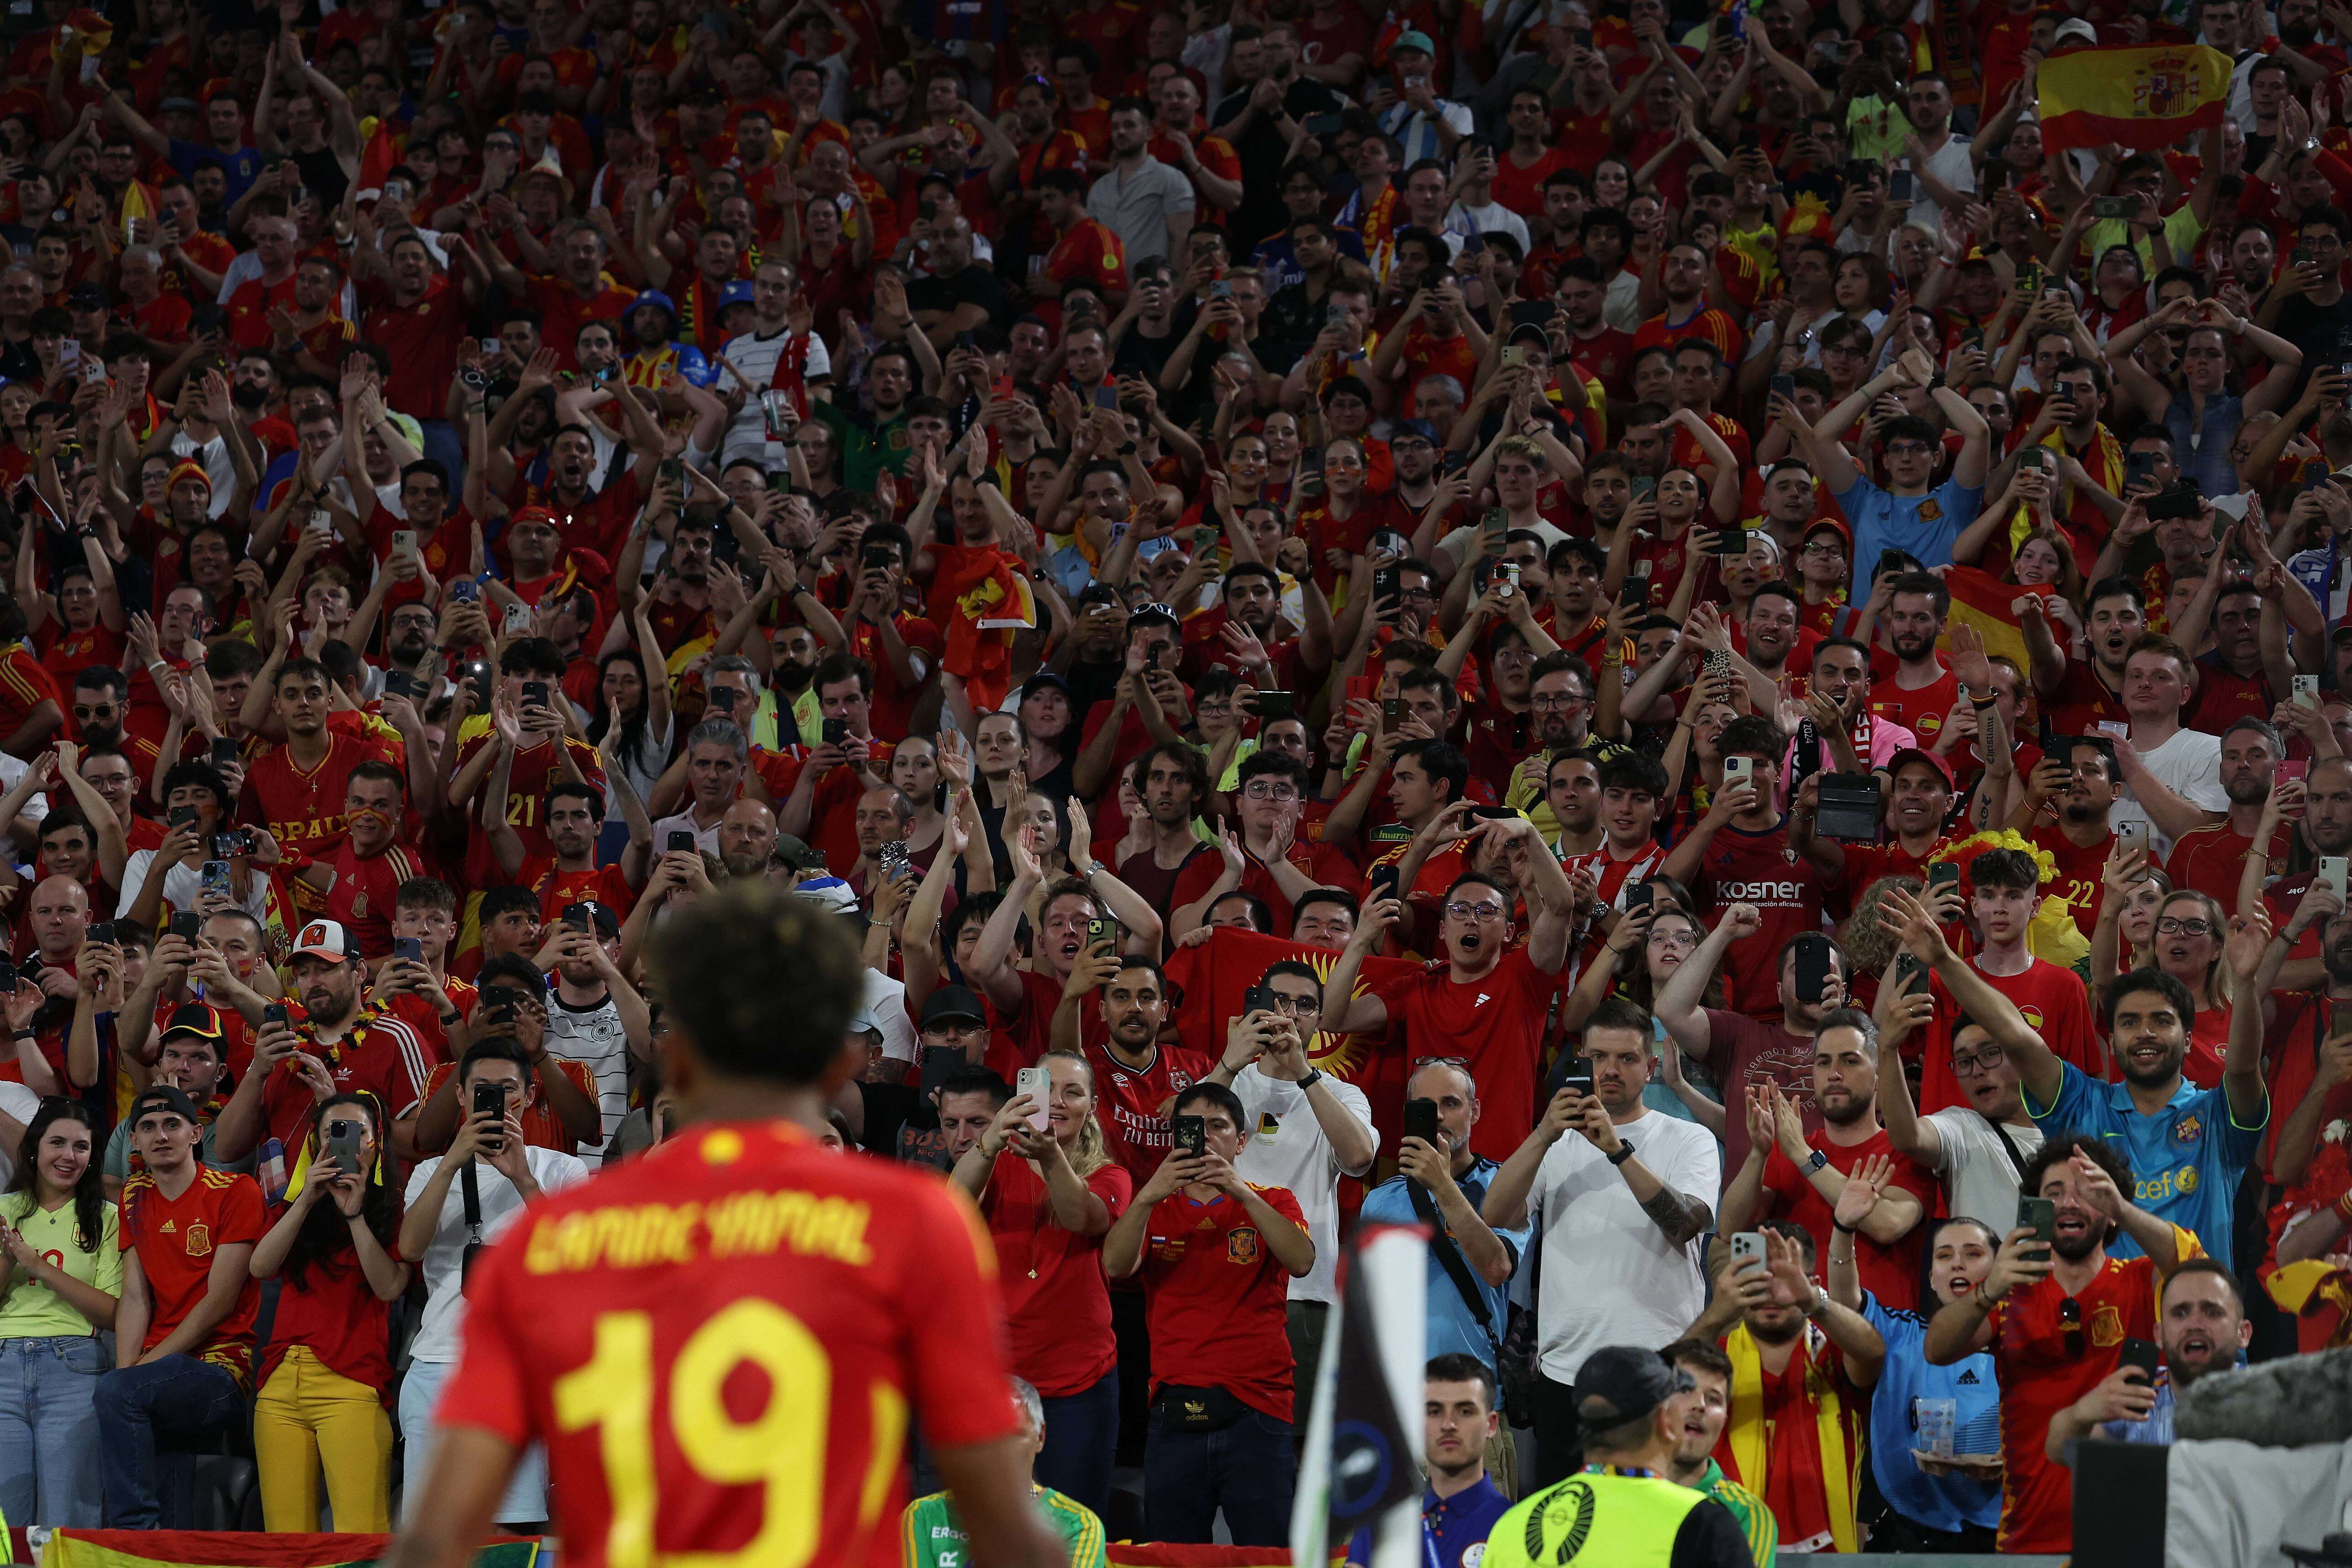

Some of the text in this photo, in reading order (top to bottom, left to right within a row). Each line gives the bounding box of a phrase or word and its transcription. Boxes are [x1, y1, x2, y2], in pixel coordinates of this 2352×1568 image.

[1803, 723, 1814, 744] 2024
[507, 793, 535, 827] 21
[2068, 879, 2094, 908] 22
[1743, 1048, 1787, 1078] MARMOT
[1114, 1102, 1171, 1130] Emira
[903, 1129, 947, 1150] BOS
[1123, 1127, 1173, 1146] FLY BETT
[2135, 1171, 2173, 1200] cef
[551, 1297, 832, 1568] 19
[931, 1526, 971, 1541] ERGO
